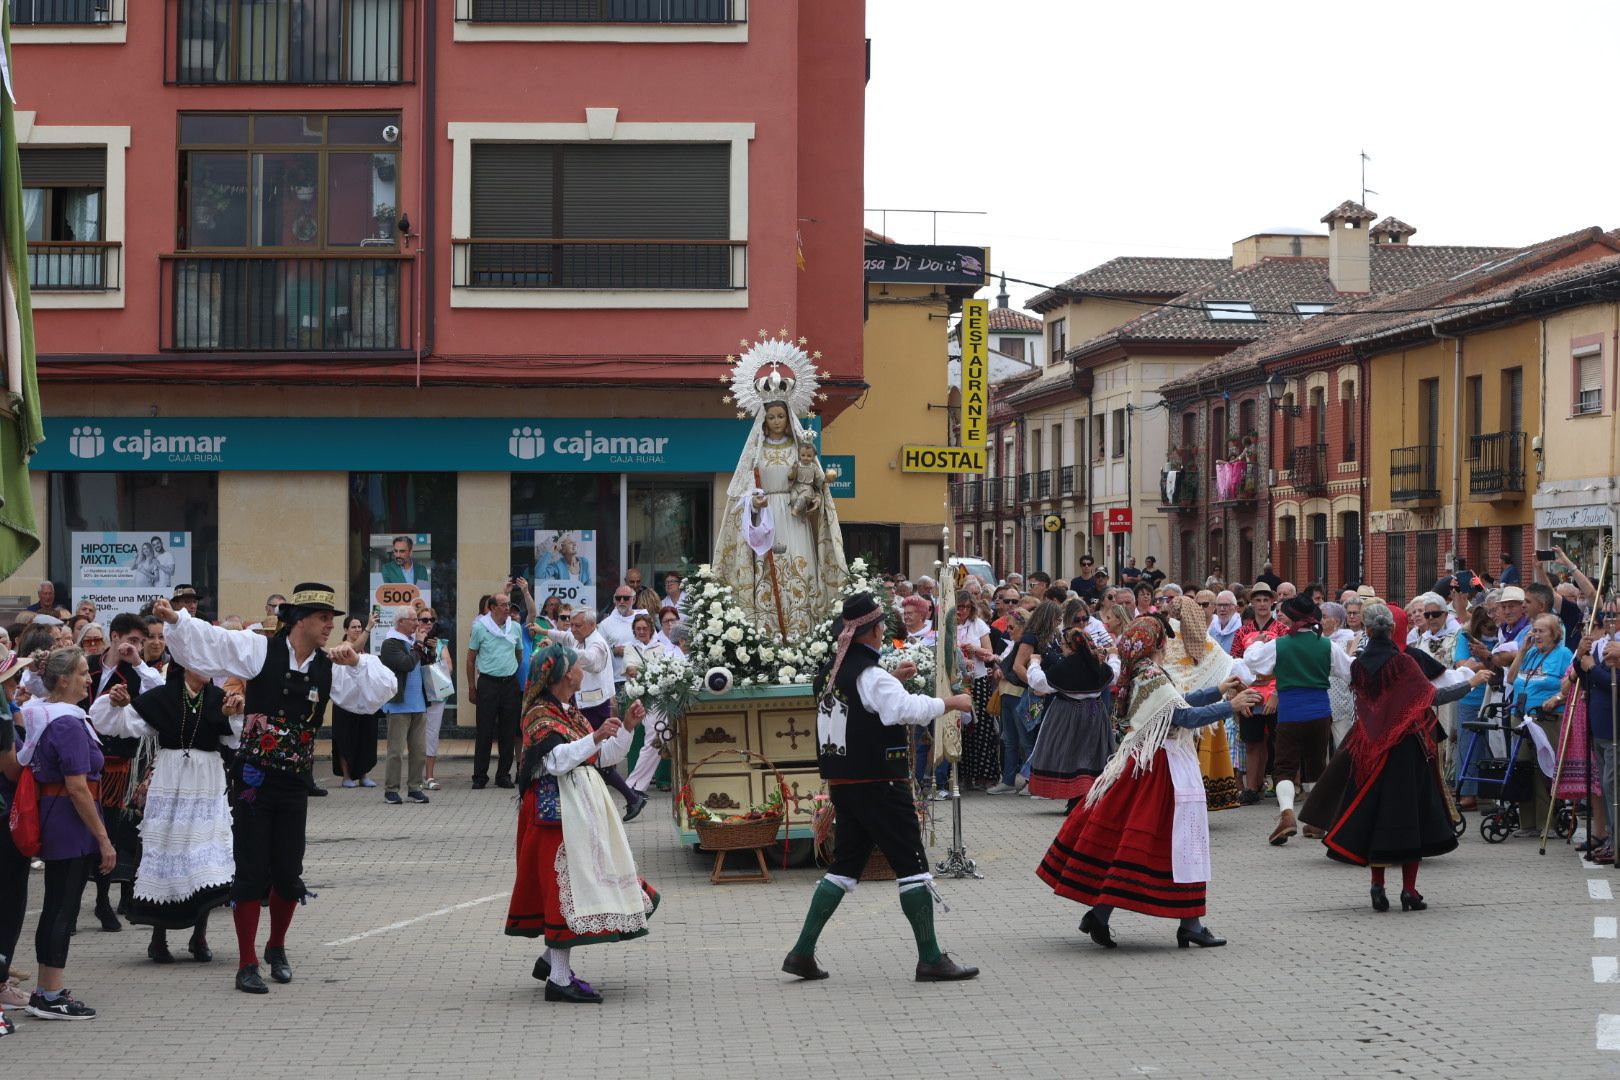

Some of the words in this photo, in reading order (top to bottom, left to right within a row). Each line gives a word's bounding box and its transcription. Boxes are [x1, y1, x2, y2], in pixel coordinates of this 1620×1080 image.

[863, 259, 886, 270] asa
[893, 255, 912, 271] Di
[968, 305, 982, 441] RESTAURANTE
[112, 429, 227, 461] cajamar
[553, 430, 669, 462] cajamar
[168, 454, 192, 463] CAJA
[194, 454, 224, 463] RURAL
[610, 455, 634, 464] CAJA
[636, 455, 666, 464] RURAL
[906, 451, 983, 469] HOSTAL
[80, 543, 139, 554] HIPOTECA
[80, 554, 117, 565] MIXTA
